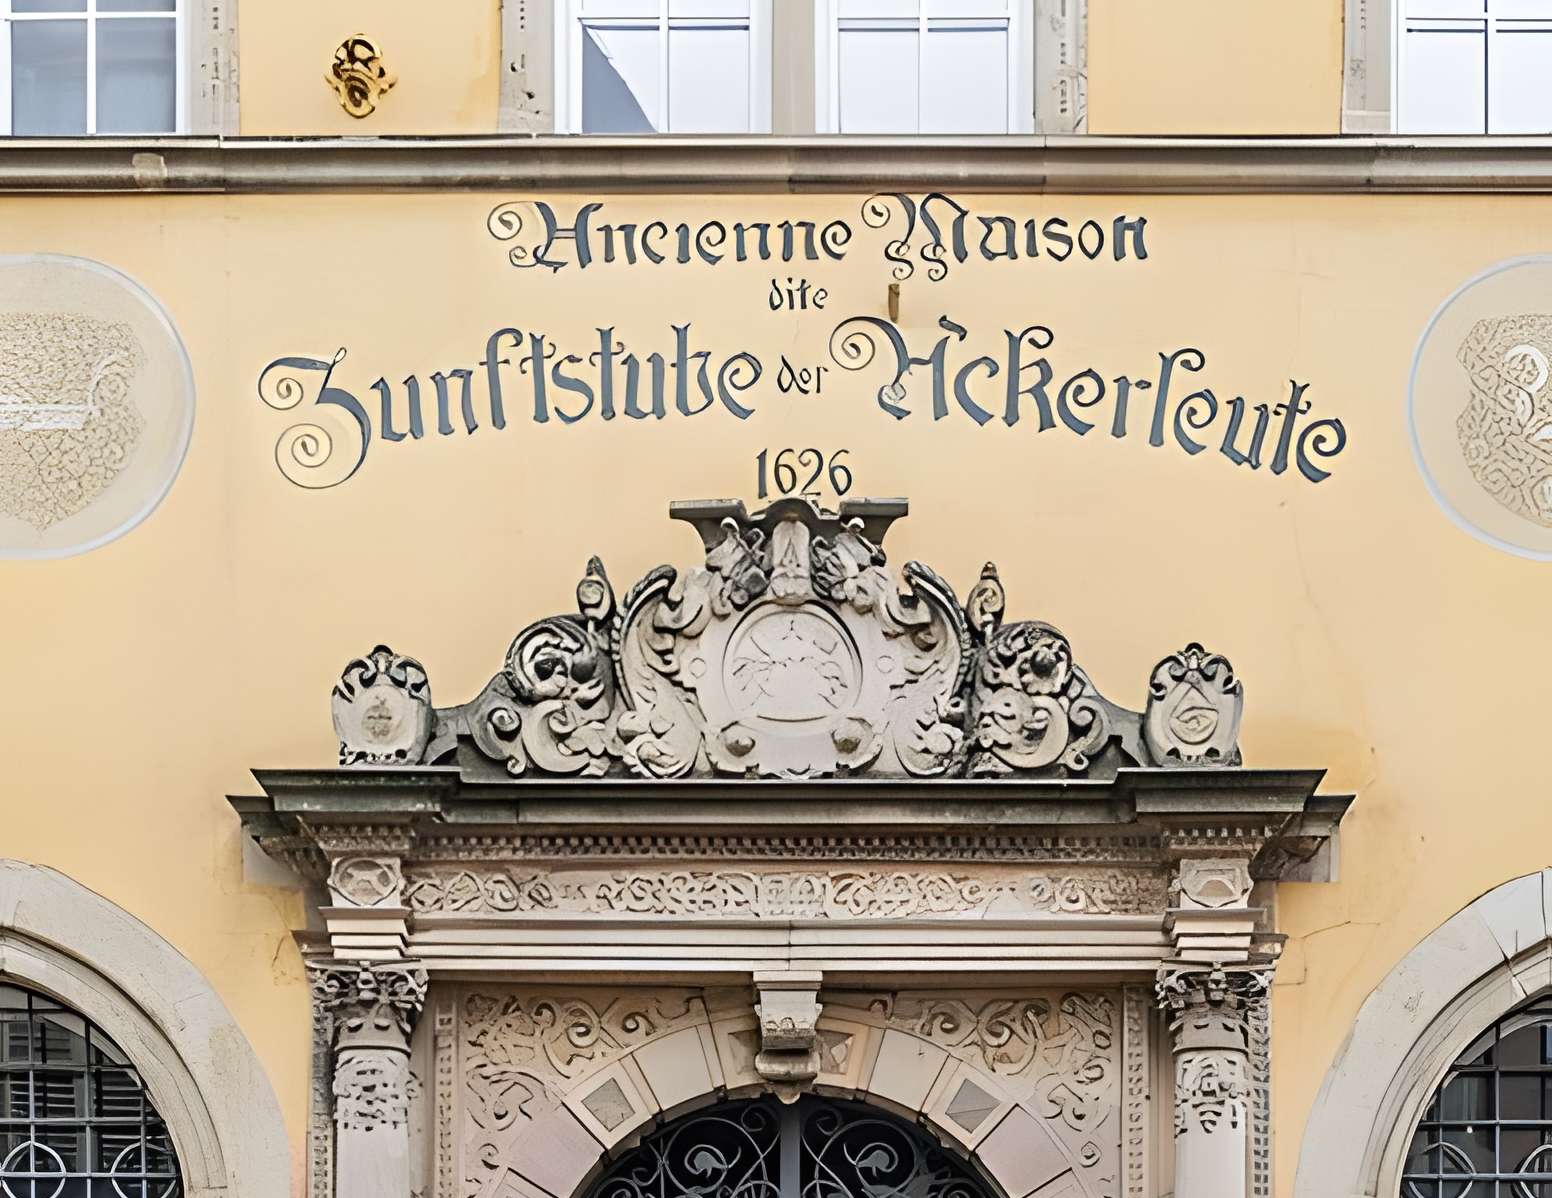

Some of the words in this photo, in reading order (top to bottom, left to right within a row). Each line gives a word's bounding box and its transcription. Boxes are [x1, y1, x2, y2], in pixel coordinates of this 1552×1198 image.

[487, 201, 853, 273] Ancienne
[860, 192, 1149, 282] Maison
[768, 277, 828, 310] dite
[257, 322, 763, 490] Zunftstube
[777, 355, 829, 395] der
[829, 314, 1347, 483] Ackerleute
[756, 447, 853, 498] 1626
